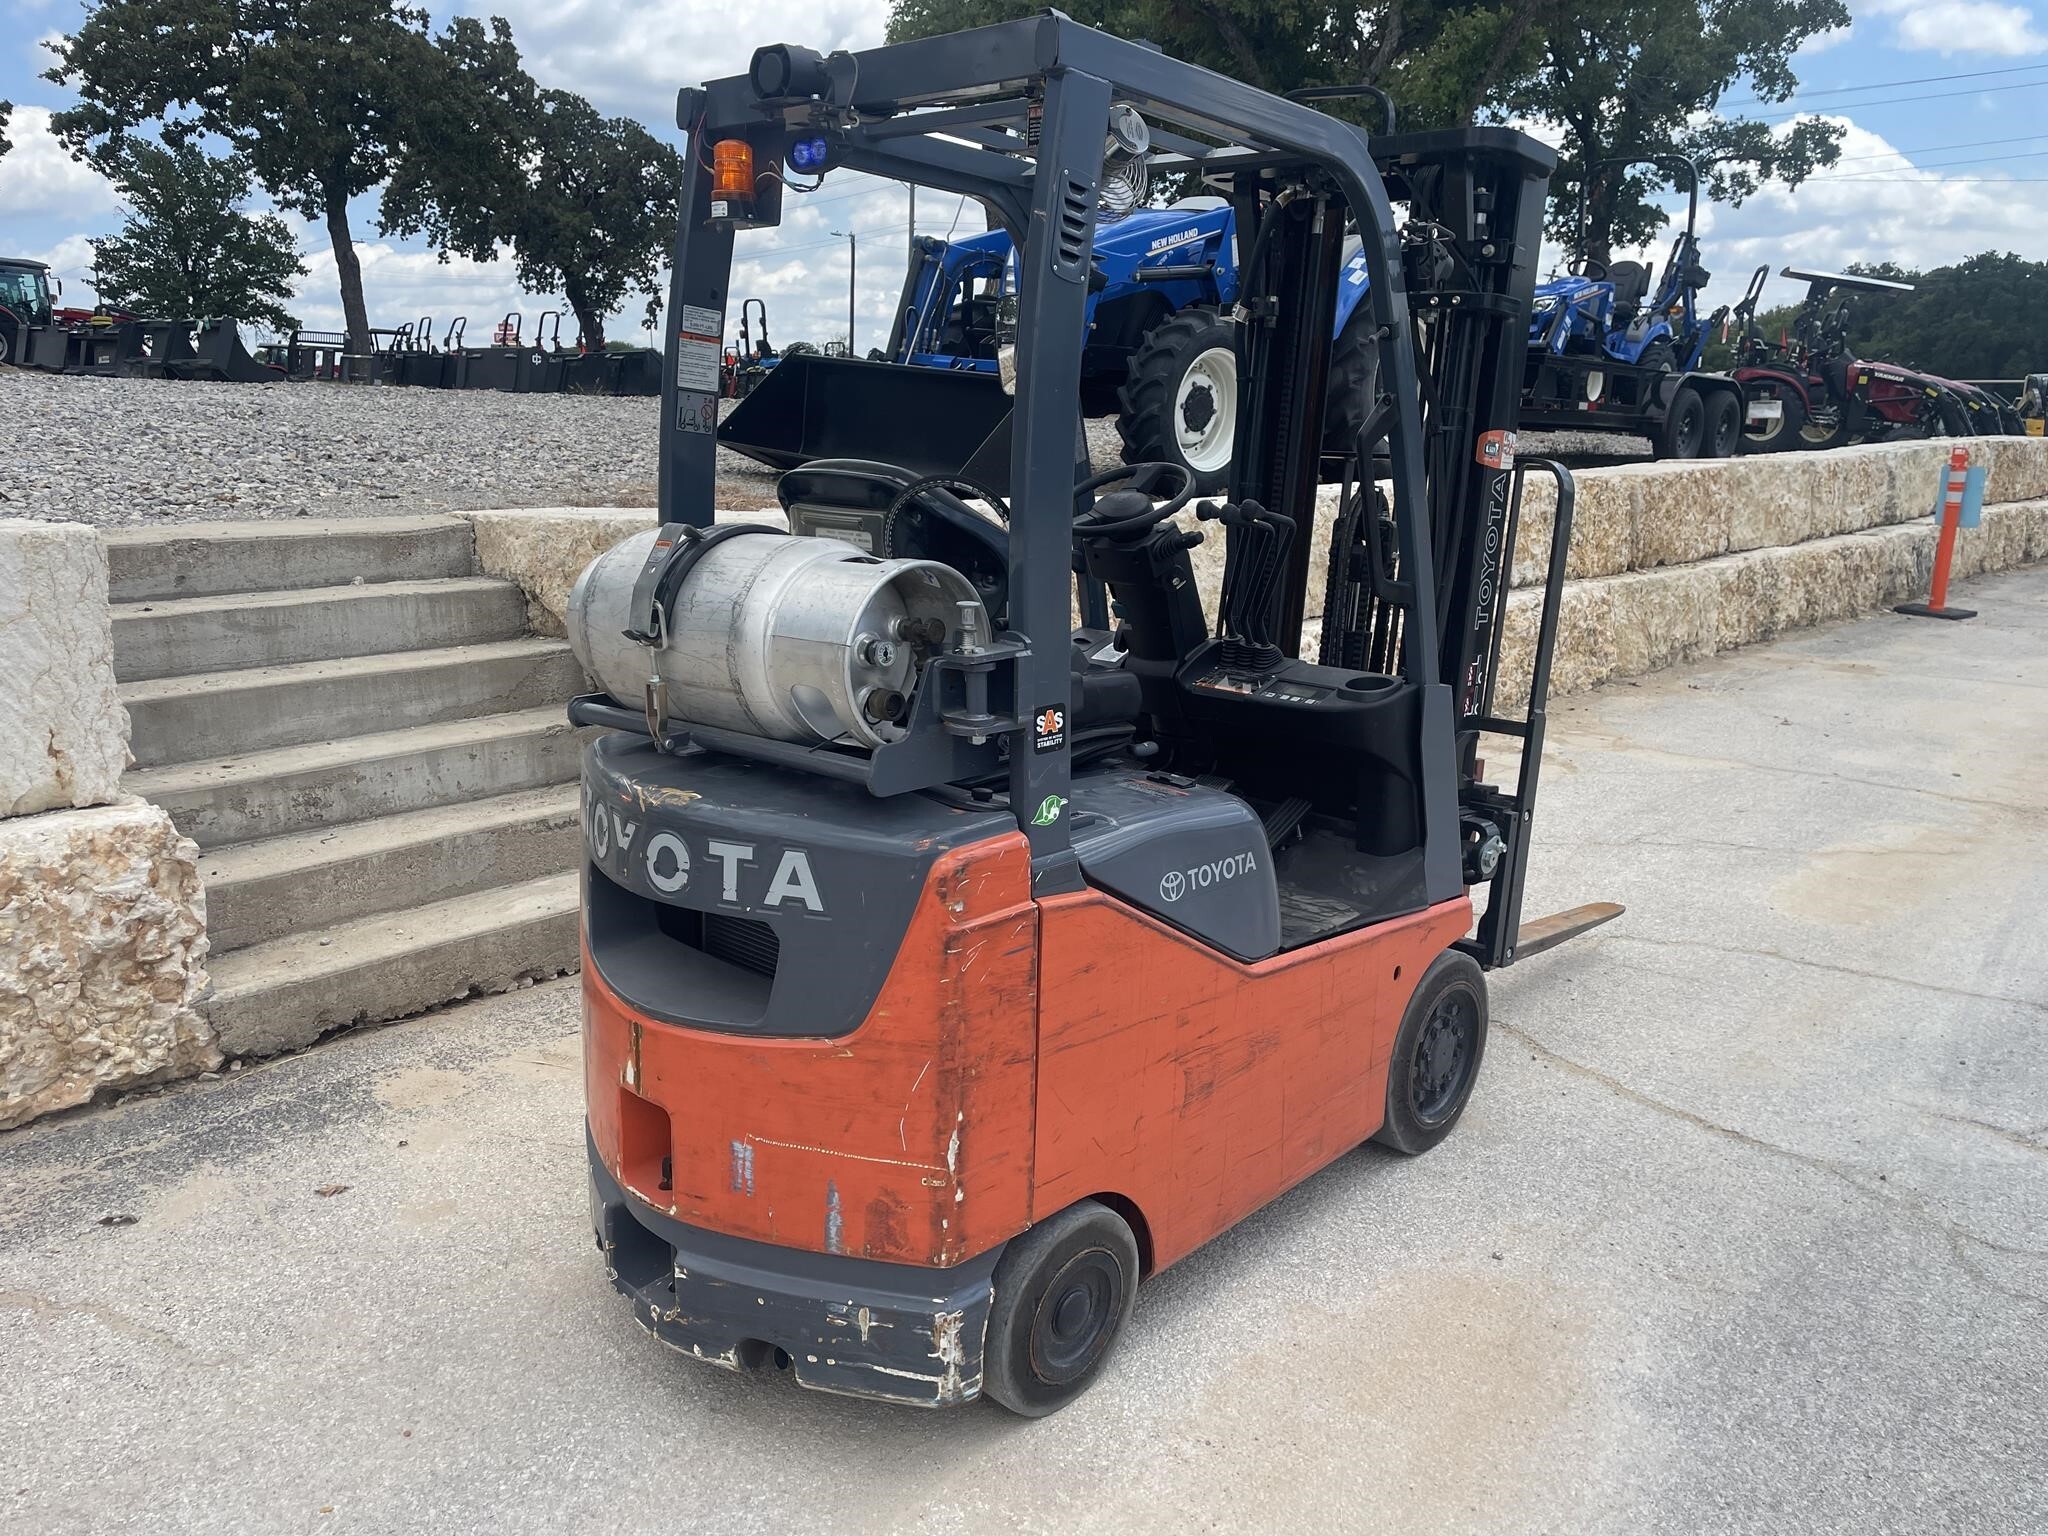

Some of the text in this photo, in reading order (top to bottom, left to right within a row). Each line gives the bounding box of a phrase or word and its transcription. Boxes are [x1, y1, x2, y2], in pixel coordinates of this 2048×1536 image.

[1152, 228, 1198, 250] NEW HOLLAND
[1475, 472, 1507, 630] TOYOTA
[1036, 709, 1063, 735] SAS
[1037, 737, 1062, 748] STABILITY
[1187, 852, 1256, 890] TOYOTA
